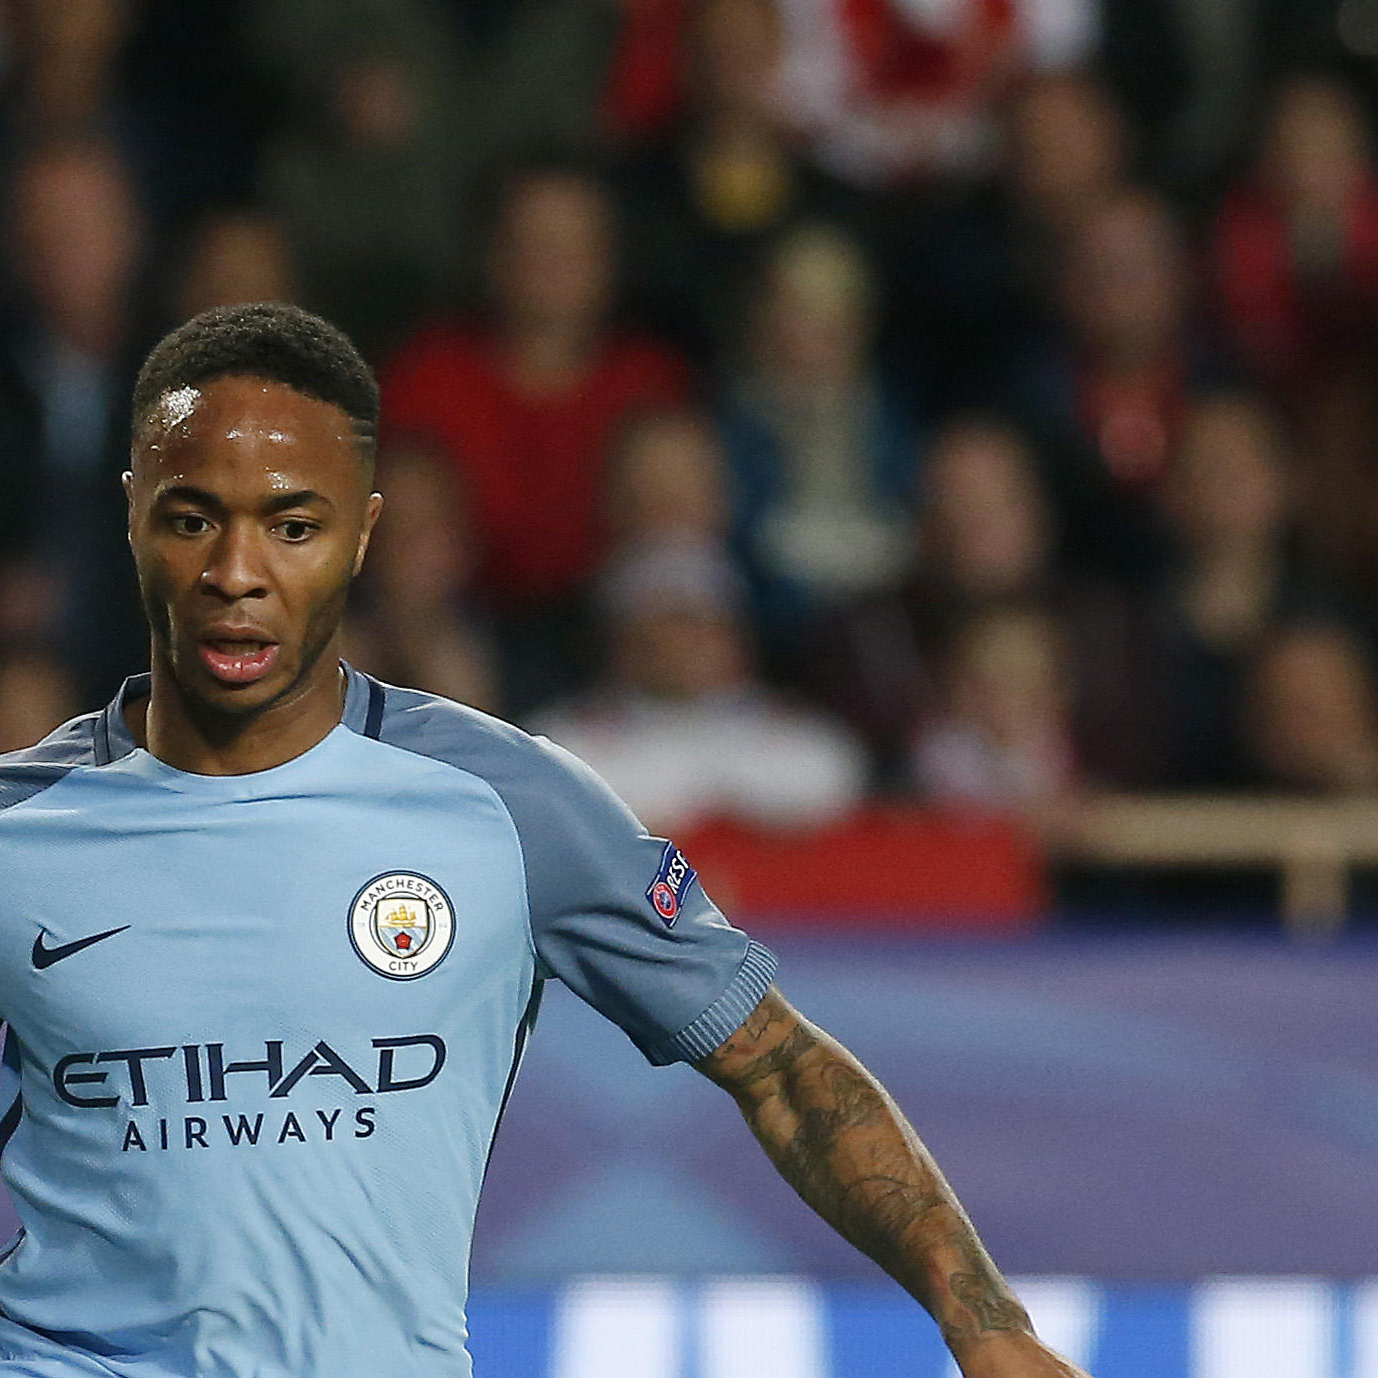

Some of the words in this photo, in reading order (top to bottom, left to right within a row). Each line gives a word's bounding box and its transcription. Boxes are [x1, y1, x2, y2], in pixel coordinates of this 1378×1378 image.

[360, 878, 444, 912] MANCHESTER
[388, 960, 418, 972] CITY
[52, 1033, 447, 1109] ETIHAD
[122, 1107, 376, 1152] AIRWAYS
